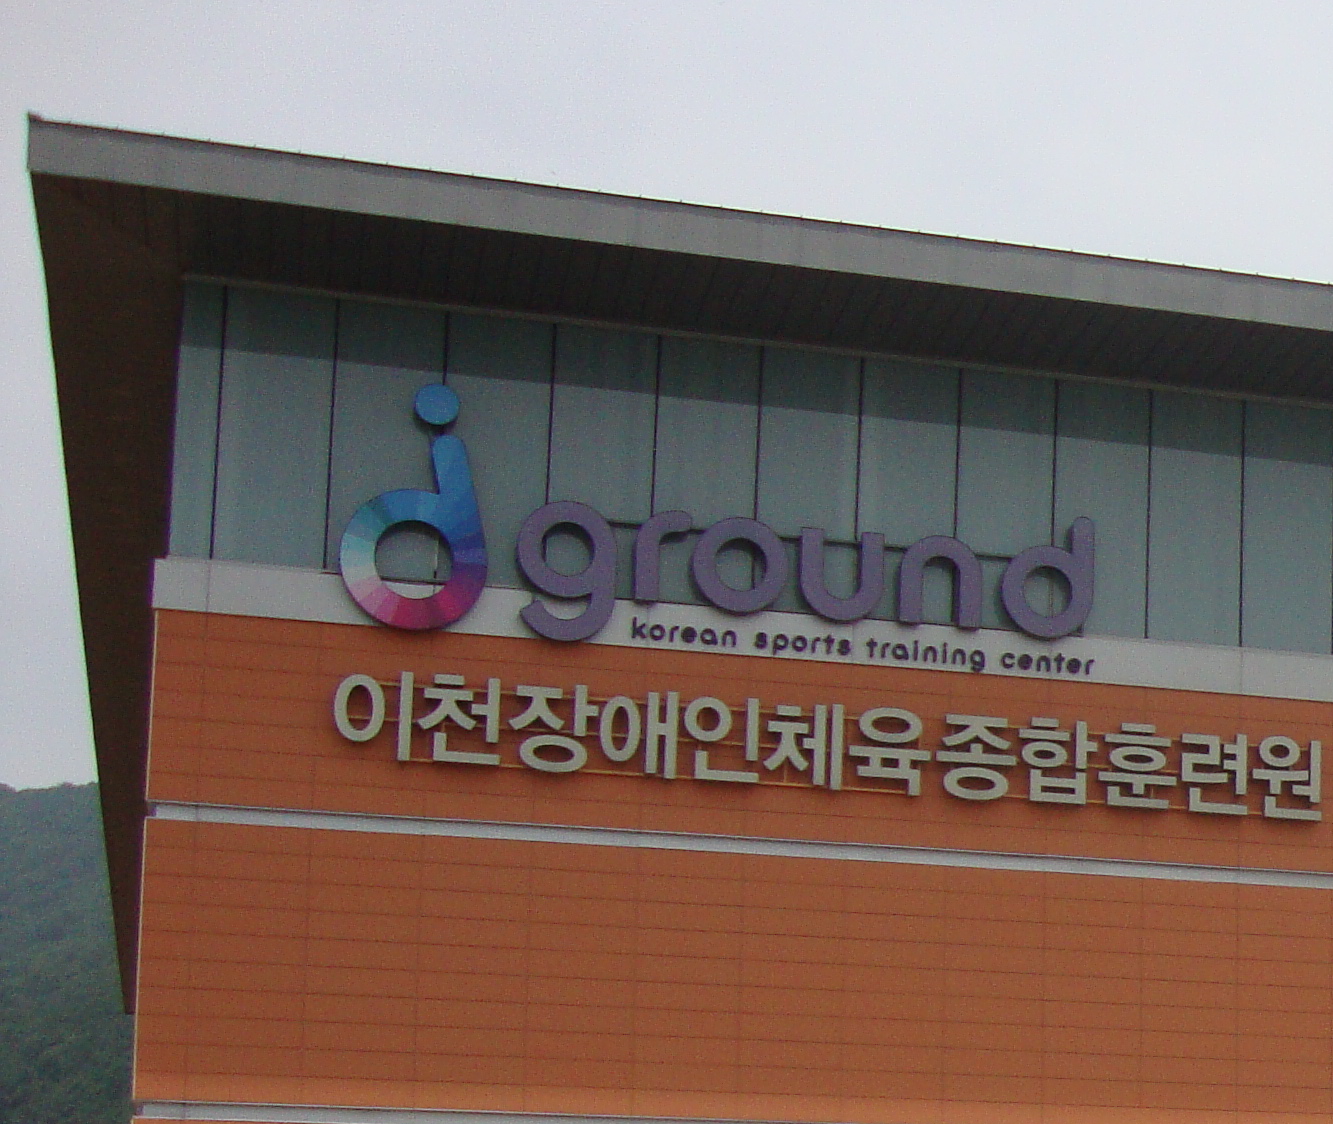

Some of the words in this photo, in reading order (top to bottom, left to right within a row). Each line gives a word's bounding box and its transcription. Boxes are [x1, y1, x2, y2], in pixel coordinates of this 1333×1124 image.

[631, 617, 737, 649] korean
[753, 631, 852, 657] sports
[866, 638, 987, 674] training
[1000, 650, 1096, 676] center
[333, 672, 1323, 822] 이천장애인체육종합훈련원
